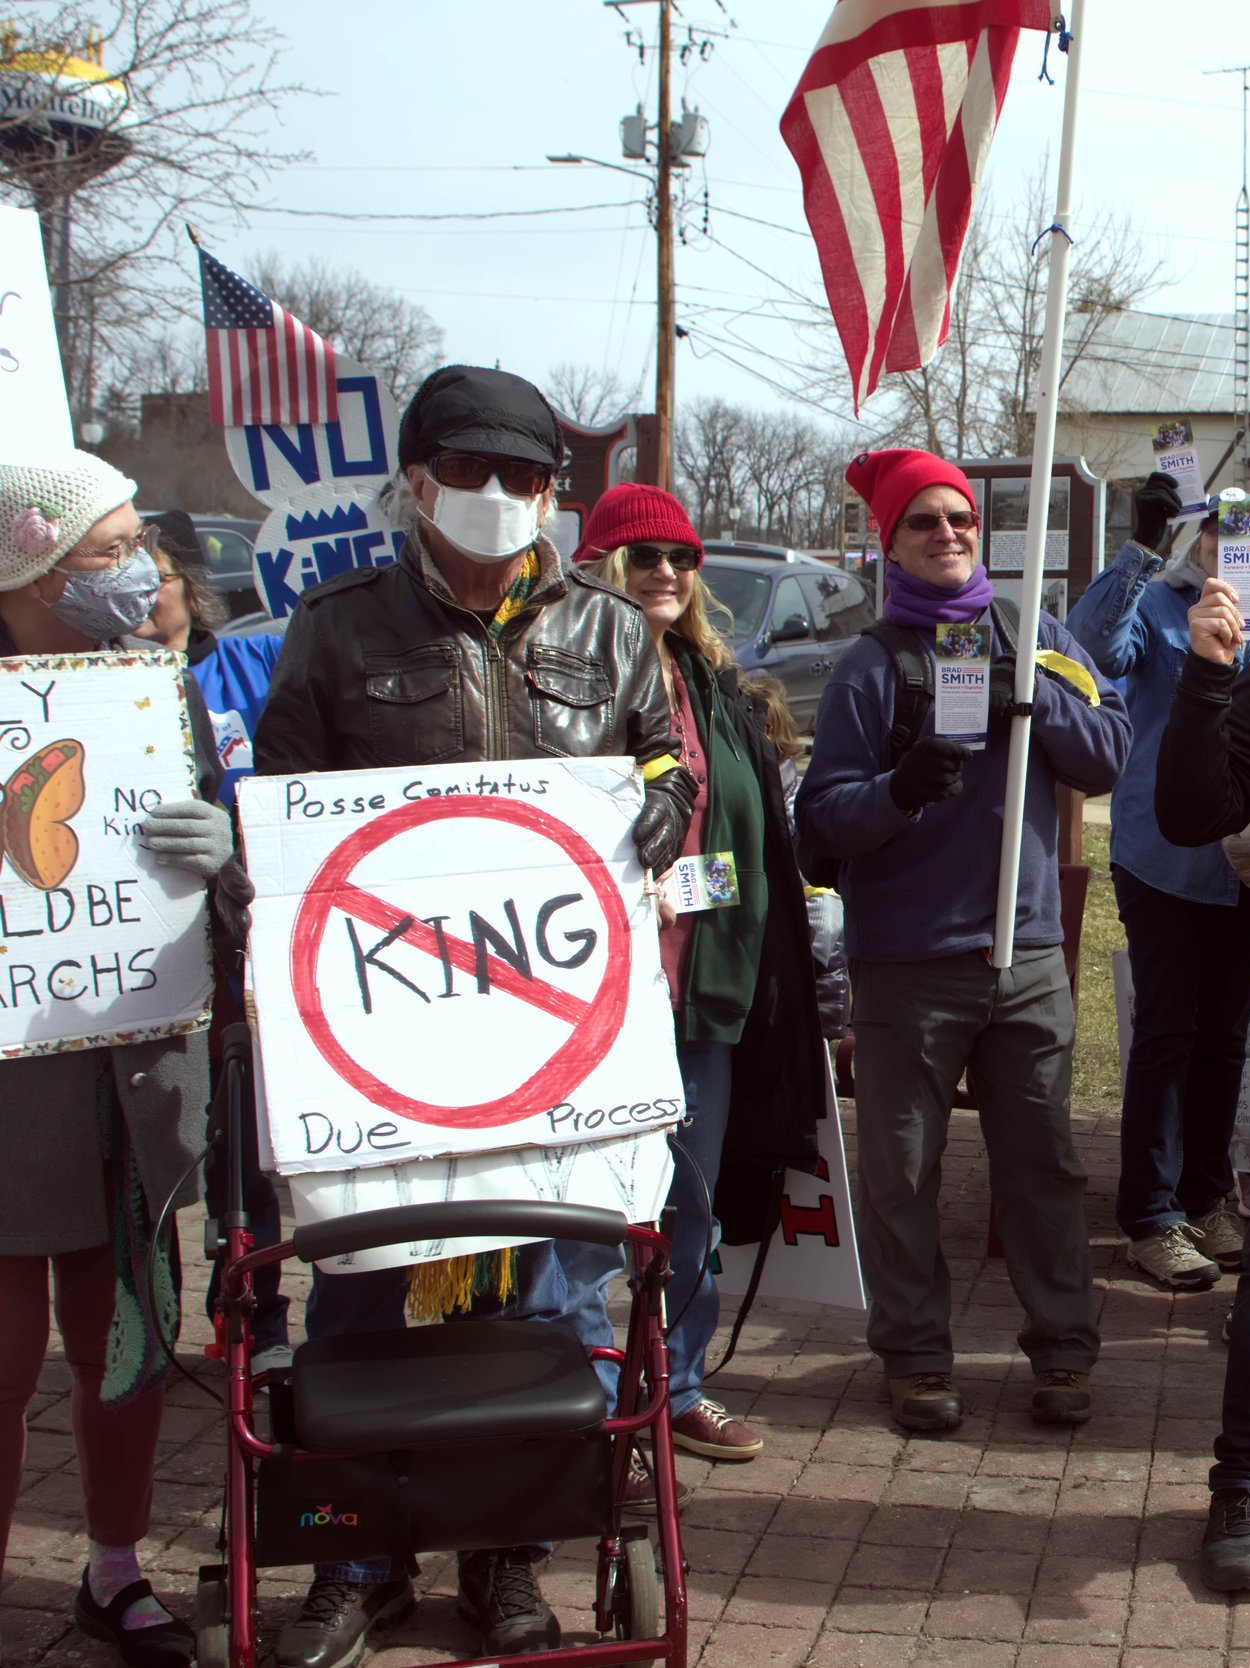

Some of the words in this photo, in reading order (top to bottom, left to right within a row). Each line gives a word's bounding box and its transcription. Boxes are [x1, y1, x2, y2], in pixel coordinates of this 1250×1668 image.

[244, 376, 388, 491] NO
[1160, 456, 1194, 470] SMITH
[941, 673, 985, 685] SMITH
[114, 787, 162, 813] NO
[286, 780, 385, 820] Posse
[678, 863, 694, 907] SMITH
[689, 862, 697, 884] BRAD
[87, 879, 141, 926] BE
[345, 893, 598, 1014] KING
[0, 948, 157, 1008] RCHS
[299, 1112, 412, 1154] Due
[547, 1098, 681, 1134] Process
[301, 1511, 357, 1527] nova
